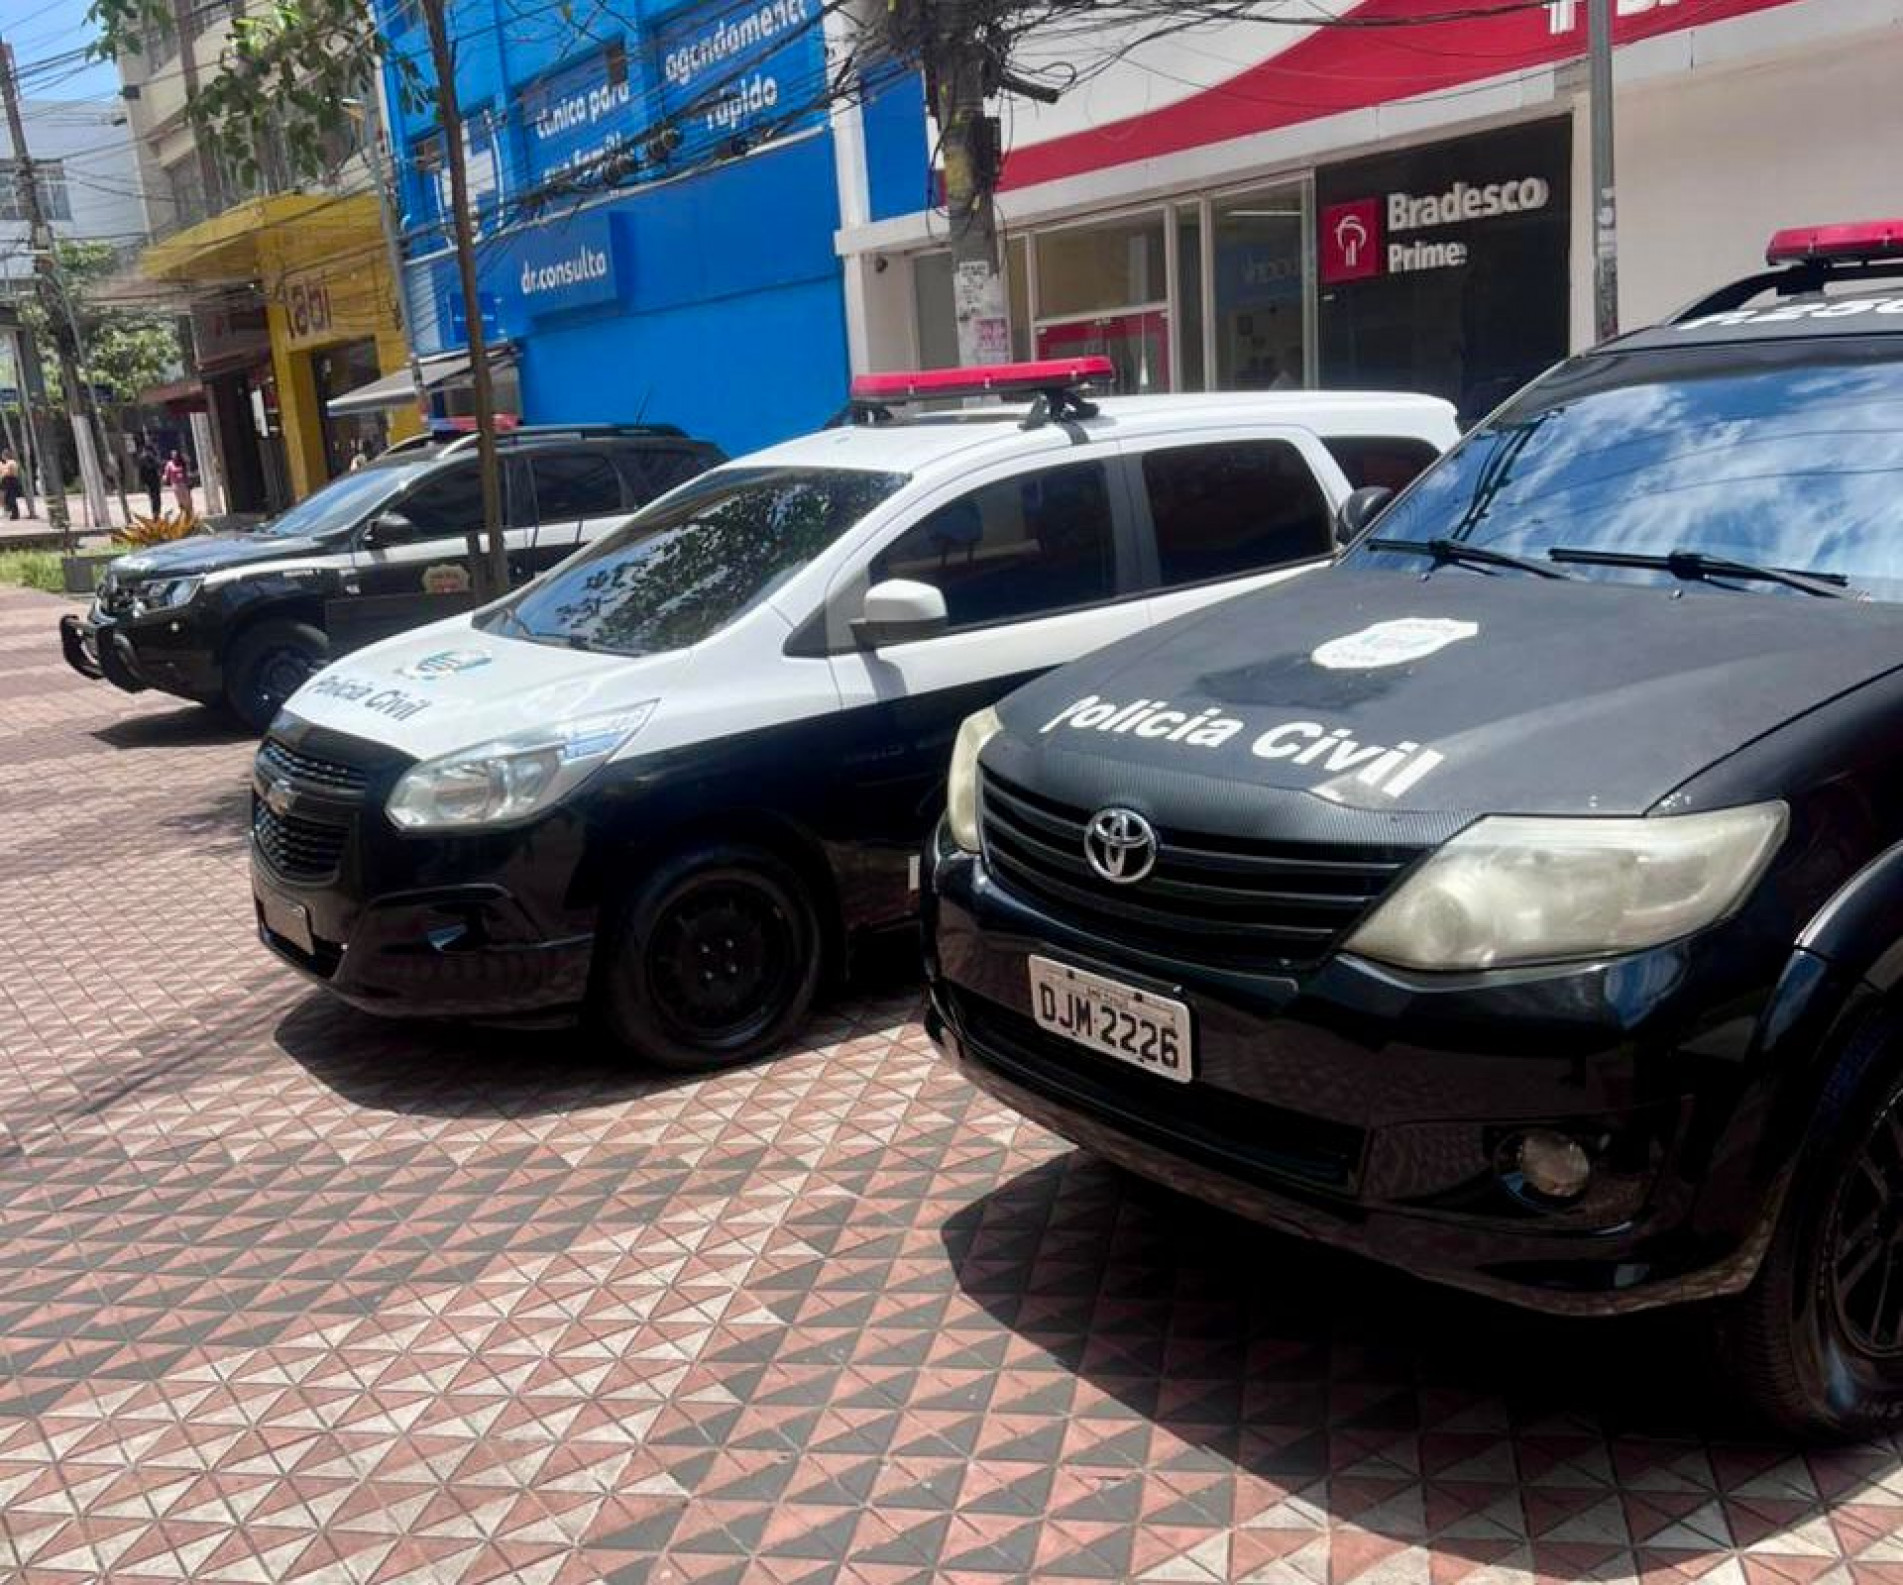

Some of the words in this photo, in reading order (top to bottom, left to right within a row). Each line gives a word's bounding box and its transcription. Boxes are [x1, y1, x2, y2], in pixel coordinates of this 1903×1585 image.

[1387, 177, 1549, 232] Bradesco
[521, 244, 607, 295] dr.consulta
[1387, 240, 1467, 273] Prime
[1252, 721, 1446, 799] Civil
